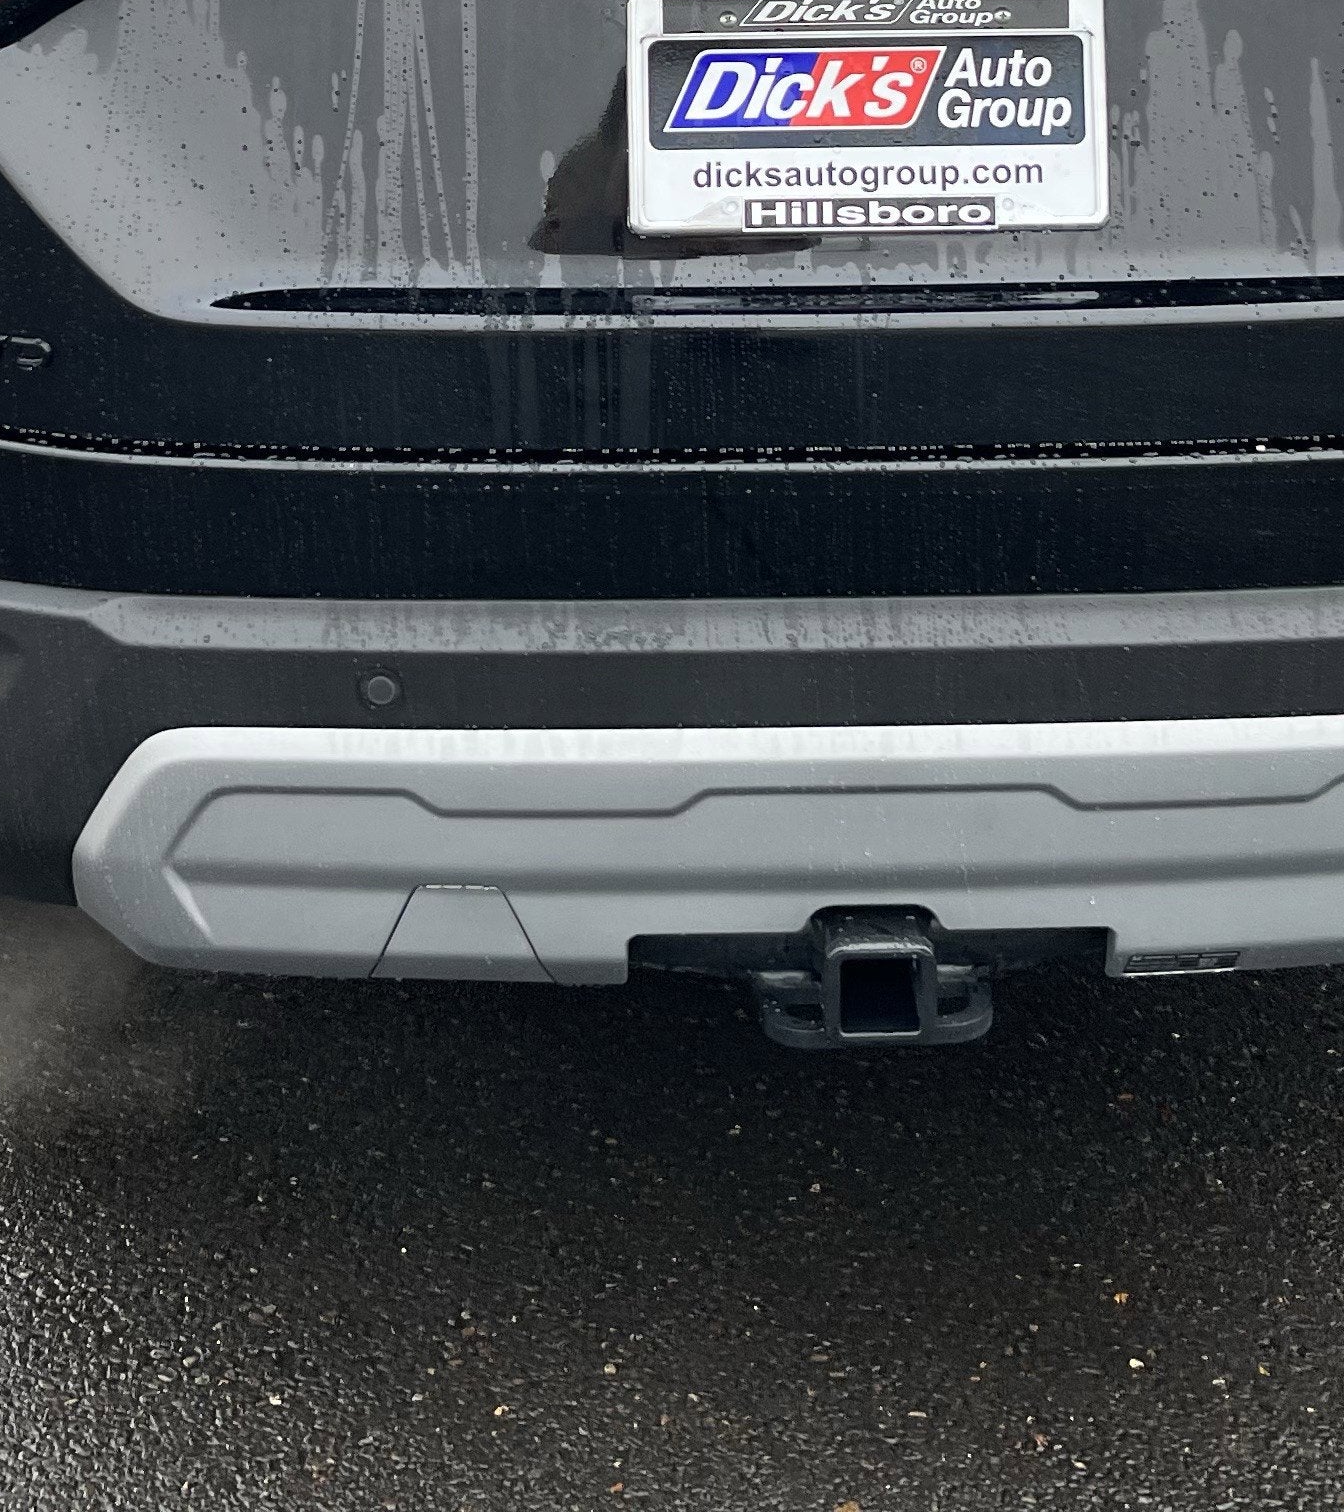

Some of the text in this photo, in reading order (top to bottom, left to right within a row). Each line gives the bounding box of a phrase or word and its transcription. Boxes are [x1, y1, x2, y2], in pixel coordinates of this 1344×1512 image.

[909, 9, 996, 26] Group
[943, 47, 1052, 88] Auto
[684, 54, 913, 122] Dick's
[937, 90, 1072, 136] Group
[693, 161, 1044, 192] dicksautogroup.com
[750, 200, 992, 227] Hillsboro
